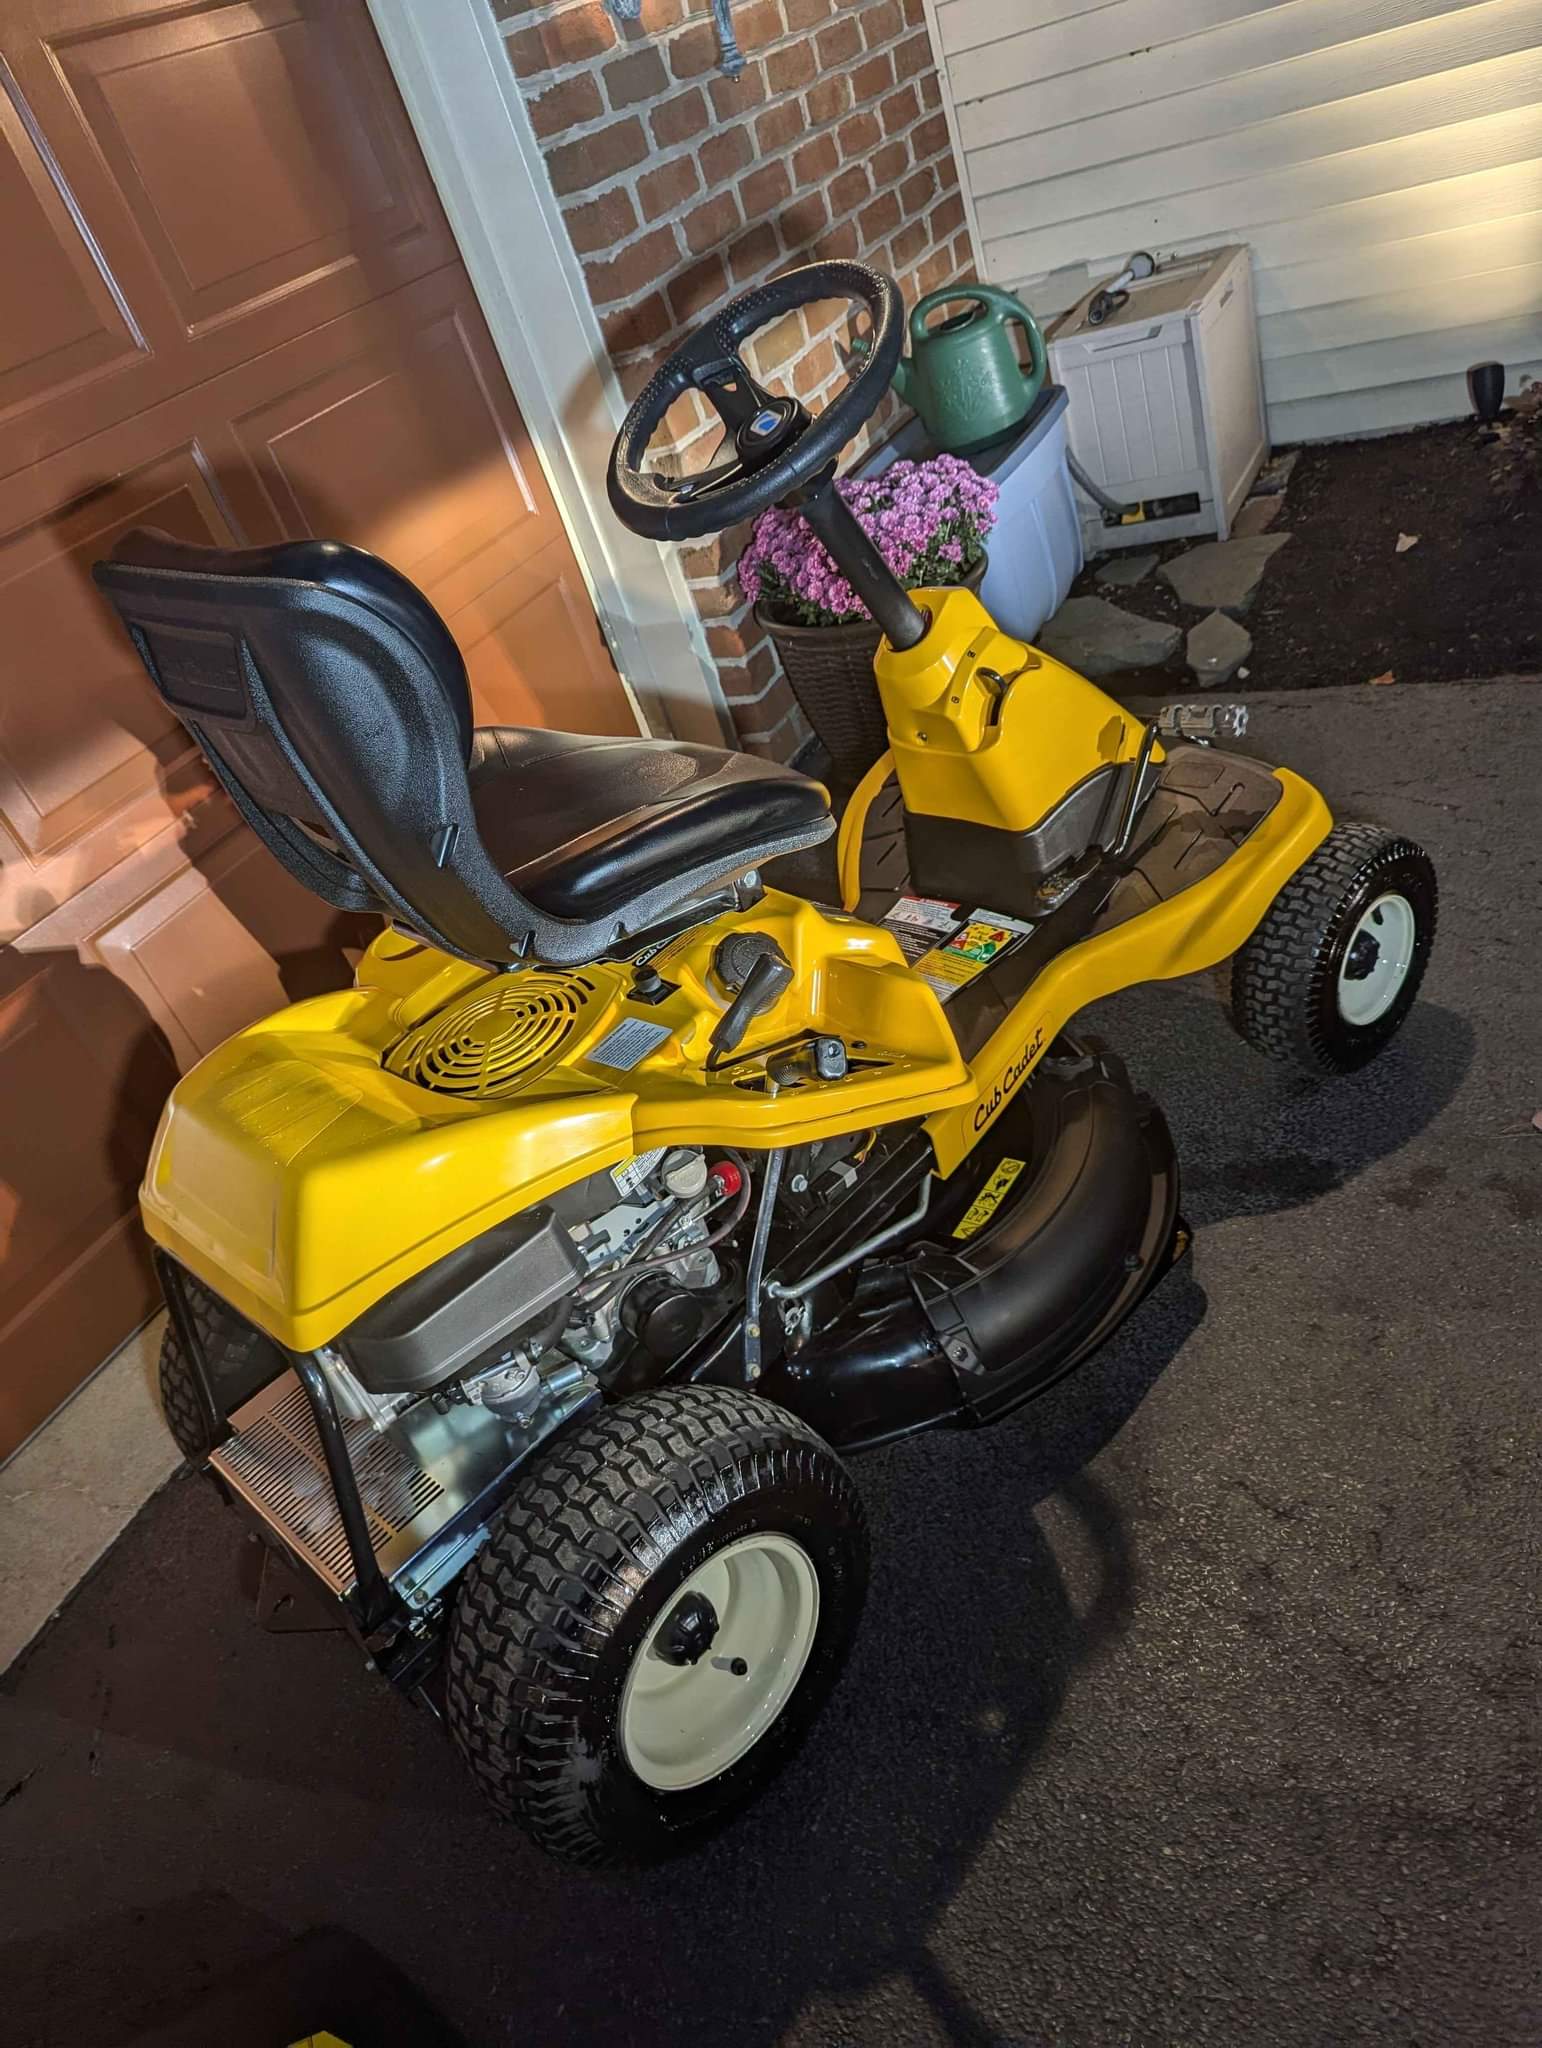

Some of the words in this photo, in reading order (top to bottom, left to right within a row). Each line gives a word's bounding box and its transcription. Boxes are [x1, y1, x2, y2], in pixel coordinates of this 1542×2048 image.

[635, 948, 658, 967] Cub
[974, 1085, 1002, 1132] Cub
[1003, 1027, 1044, 1094] Cadet
